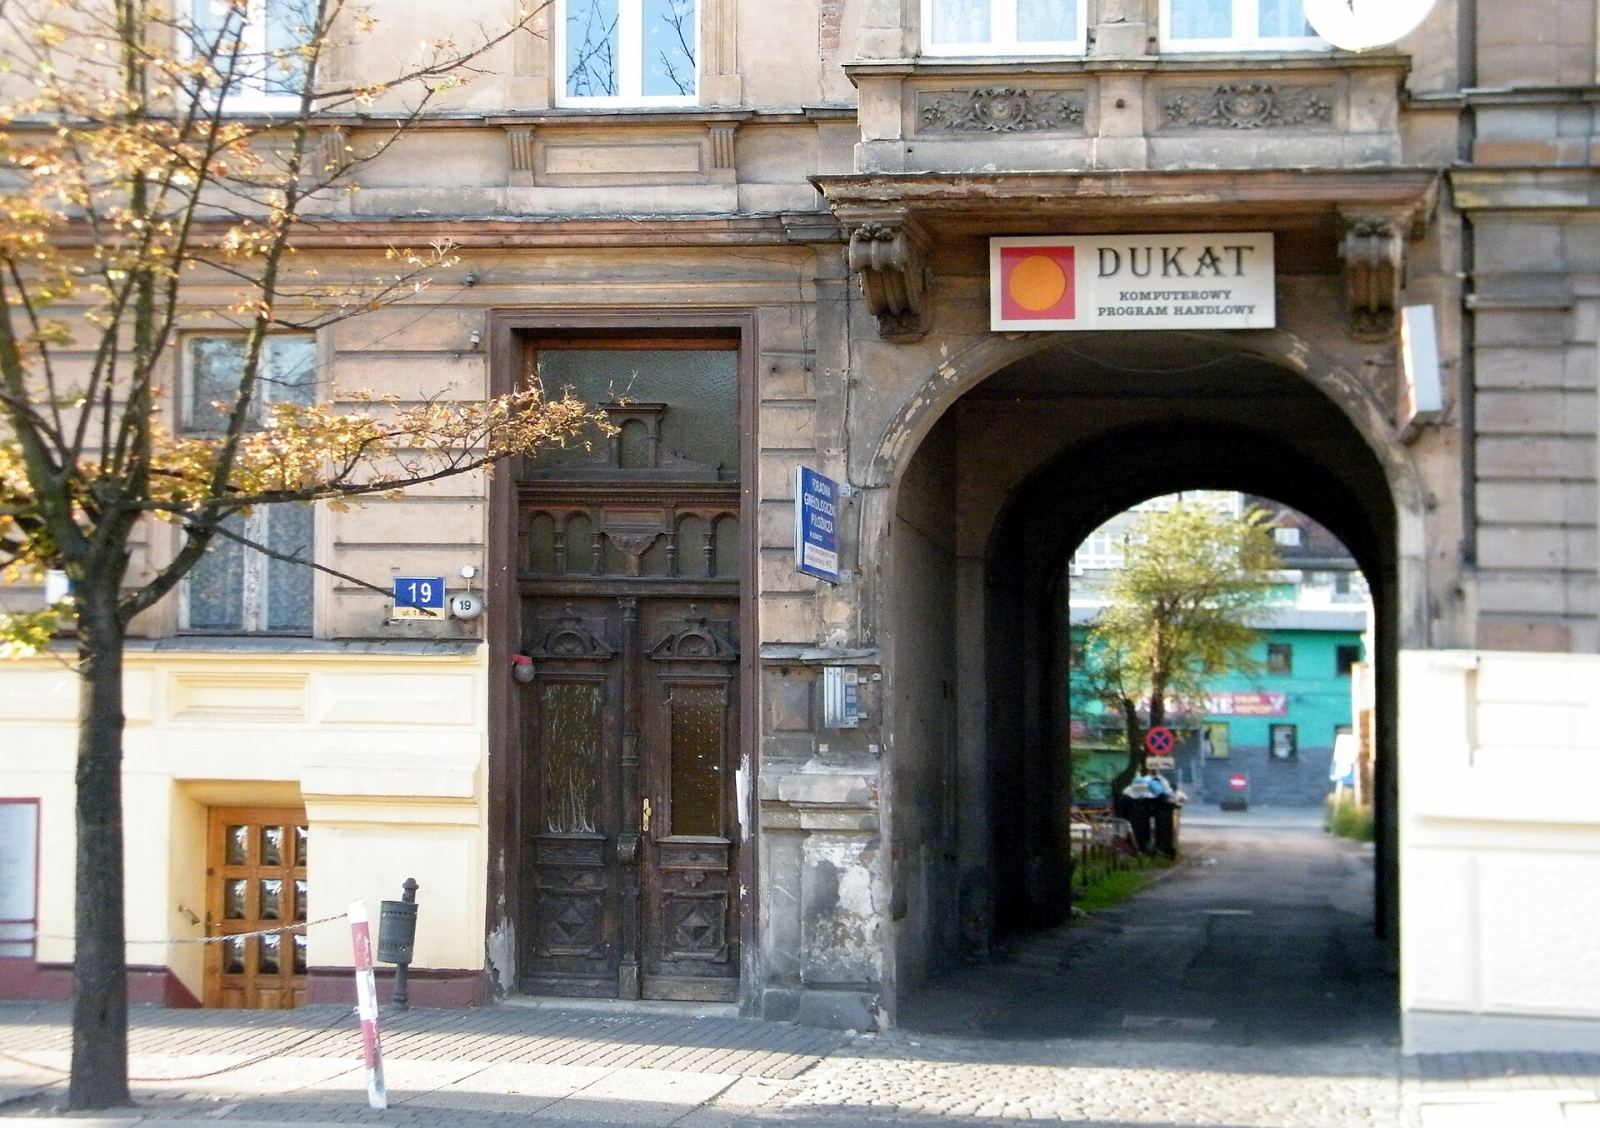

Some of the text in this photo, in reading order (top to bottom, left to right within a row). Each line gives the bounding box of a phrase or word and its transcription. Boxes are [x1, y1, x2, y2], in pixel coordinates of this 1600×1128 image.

[1097, 245, 1255, 278] DUKAT
[1119, 290, 1232, 301] KOMPUTEROWY
[1098, 304, 1256, 317] PROGRAM HANDLOWY
[408, 582, 432, 603] 19
[459, 600, 472, 611] 19
